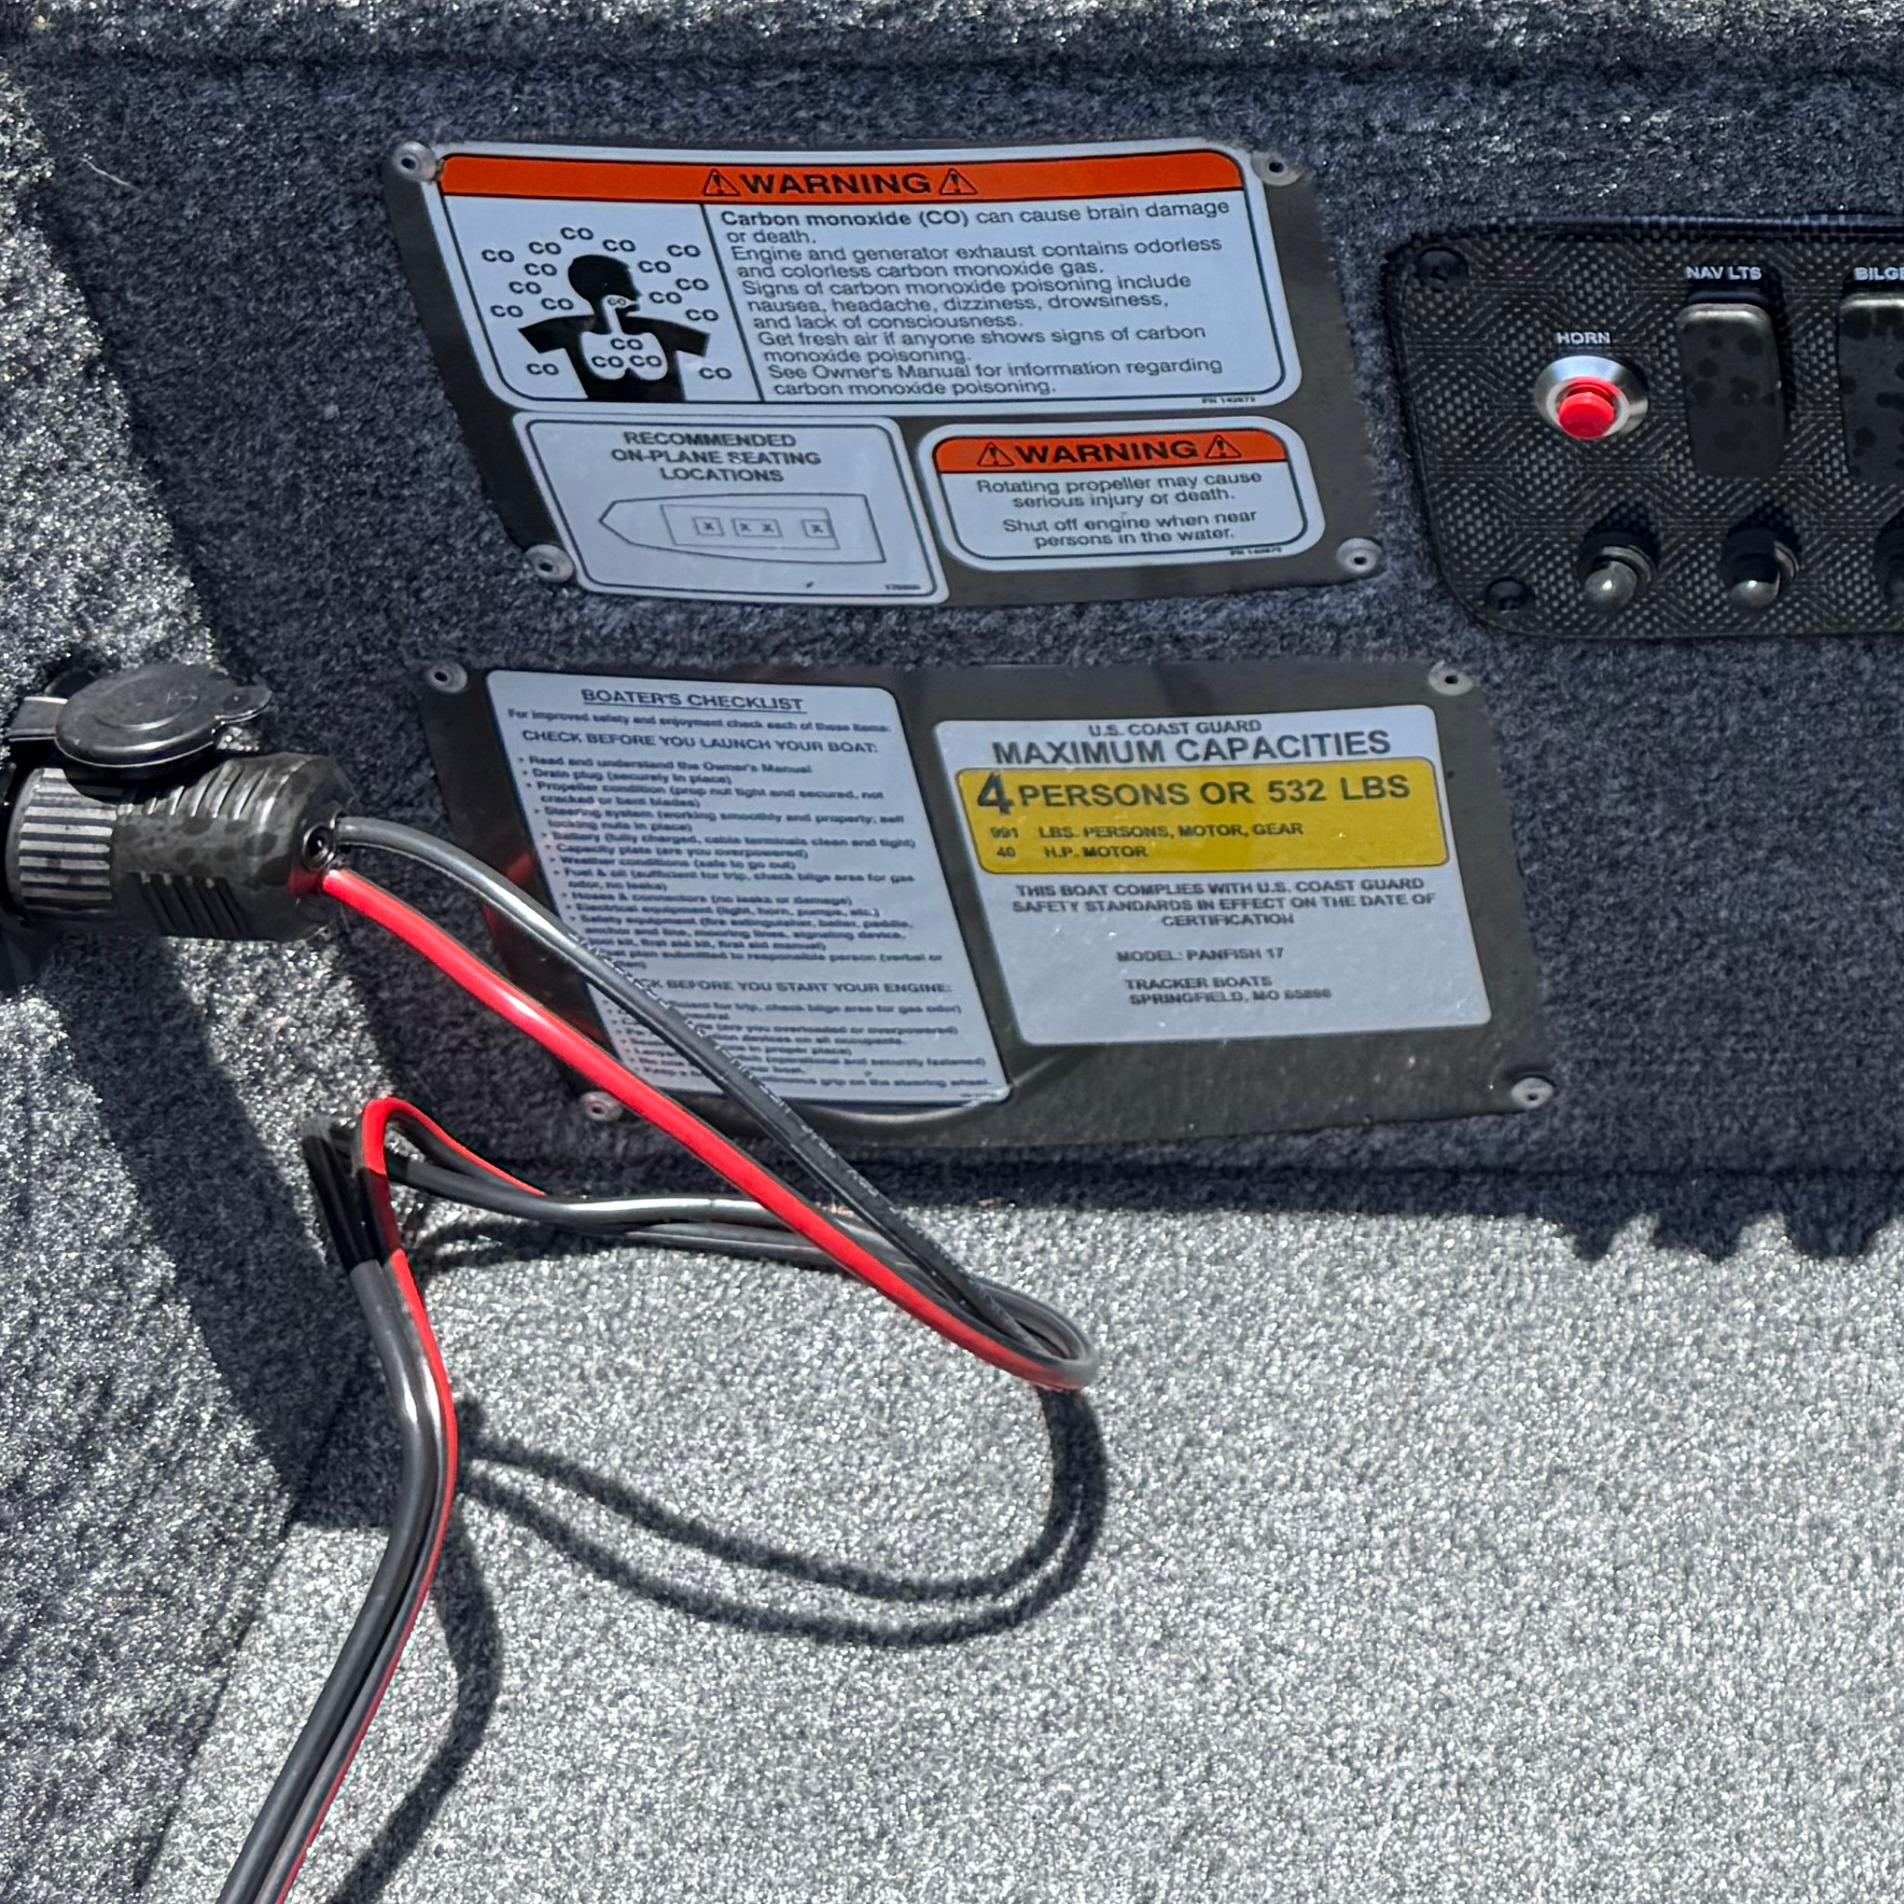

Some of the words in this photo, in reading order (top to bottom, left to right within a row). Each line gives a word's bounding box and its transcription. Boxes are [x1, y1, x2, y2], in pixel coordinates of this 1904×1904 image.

[740, 173, 932, 195] WARNING
[721, 210, 799, 226] Carbon
[806, 210, 912, 226] monoxide
[919, 209, 969, 228] (CO)
[976, 210, 1014, 225] can
[1020, 207, 1082, 223] cause
[1086, 204, 1140, 221] brain
[1145, 199, 1230, 220] damage
[560, 227, 594, 241] CO
[727, 231, 746, 244] or
[753, 229, 817, 244] death.
[481, 249, 515, 263] CO
[528, 241, 562, 255] CO
[731, 245, 802, 265] Engine
[809, 246, 847, 261] and
[852, 247, 949, 264] generator
[956, 244, 1036, 261] exhaust
[1041, 241, 1129, 258] contains
[1134, 237, 1223, 255] odorless
[524, 263, 558, 276] CO
[737, 264, 776, 278] and
[781, 264, 872, 279] colorless
[877, 263, 948, 278] carbon
[954, 260, 1054, 277] monoxide
[1060, 263, 1104, 278] gas.
[1685, 265, 1724, 280] NAV
[1727, 265, 1762, 280] LTS
[508, 281, 542, 295] CO
[742, 281, 799, 298] Signs
[805, 281, 823, 295] of
[830, 281, 900, 296] carbon
[906, 279, 1006, 295] monoxide
[1013, 277, 1112, 295] poisoning
[1117, 273, 1192, 290] include
[541, 298, 574, 311] CO
[747, 300, 826, 315] nausea,
[832, 298, 938, 314] headache,
[944, 296, 1042, 313] dizziness,
[1048, 293, 1169, 310] drowsiness,
[685, 309, 719, 322] CO
[753, 316, 791, 330] and
[797, 315, 836, 330] lack
[843, 315, 863, 329] of
[867, 314, 1024, 330] consciousness.
[758, 331, 795, 346] Get
[799, 331, 849, 346] fresh
[854, 331, 878, 346] air
[883, 330, 896, 345] if
[902, 334, 976, 348] anyone
[981, 329, 1046, 345] shows
[1051, 329, 1105, 346] signs
[1111, 327, 1130, 341] of
[1135, 325, 1206, 341] carbon
[1556, 330, 1612, 347] HORN
[591, 355, 625, 368] CO
[764, 348, 862, 363] monoxide
[867, 348, 972, 365] poisoning.
[526, 363, 560, 376] CO
[768, 365, 807, 380] See
[812, 365, 893, 380] Owner's
[898, 365, 970, 379] Manual
[975, 363, 1002, 378] for
[1007, 361, 1121, 378] information
[1126, 359, 1223, 376] regarding
[773, 382, 842, 396] carbon
[850, 381, 946, 395] monoxide
[952, 380, 1056, 398] poisoning.
[623, 430, 797, 448] RECOMMENDED
[612, 449, 723, 464] ON-PLANE
[727, 450, 823, 466] SEATING
[1013, 440, 1198, 465] WARNING
[660, 467, 785, 483] LOCATIONS
[977, 479, 1060, 496] Rotating
[1066, 476, 1151, 496] propeller
[1158, 476, 1198, 491] may
[1204, 471, 1263, 486] cause
[1013, 493, 1085, 509] serious
[1090, 493, 1145, 510] injury
[1151, 494, 1170, 506] or
[1175, 487, 1235, 503] death.
[1003, 518, 1048, 533] Shut
[1054, 517, 1078, 532] off
[1084, 517, 1150, 534] engine
[1156, 513, 1210, 528] when
[1215, 510, 1258, 524] near
[1033, 534, 1113, 550] persons
[1119, 531, 1137, 545] in
[1142, 530, 1172, 545] the
[1178, 528, 1235, 543] water.
[581, 688, 681, 706] BOATER'S
[686, 693, 804, 711] CHECKLIST
[1089, 723, 1123, 738] U.S.
[1130, 721, 1191, 737] COAST
[1196, 718, 1263, 734] GUARD
[522, 729, 582, 743] CHECK
[586, 732, 656, 746] BEFORE
[659, 736, 696, 748] YOU
[700, 737, 771, 750] LAUNCH
[774, 739, 824, 752] YOUR
[992, 739, 1166, 766] MAXIMUM
[1176, 729, 1392, 762] CAPACITIES
[975, 771, 1014, 815] 4
[1018, 780, 1191, 809] PERSONS
[1199, 779, 1254, 806] OR
[1267, 777, 1327, 803] 532
[1339, 774, 1411, 801] LBS
[1083, 824, 1175, 840] PERSONS,
[1179, 822, 1249, 839] MOTOR,
[1252, 821, 1304, 837] GEAR
[996, 846, 1017, 859] 40
[1083, 844, 1149, 859] MOTOR
[1016, 884, 1057, 898] THIS
[1060, 883, 1109, 897] BOAT
[1113, 882, 1204, 897] COMPLIES
[1208, 881, 1253, 896] WITH
[1256, 880, 1291, 894] U.S.
[1295, 879, 1356, 893] COAST
[1360, 877, 1425, 892] GUARD
[1012, 899, 1079, 914] SAFETY
[1085, 898, 1193, 913] STANDARDS
[1197, 898, 1215, 911] IN
[1219, 897, 1286, 911] EFFECT
[1290, 896, 1318, 909] ON
[1321, 895, 1357, 909] THE
[1361, 894, 1409, 908] DATE
[1413, 892, 1437, 906] OF
[1162, 912, 1295, 927] CERTIFICATION
[1186, 947, 1263, 962] PANFISH
[1266, 946, 1285, 960] 17
[1125, 976, 1209, 991] TRACKER
[1213, 975, 1273, 988] BOATS
